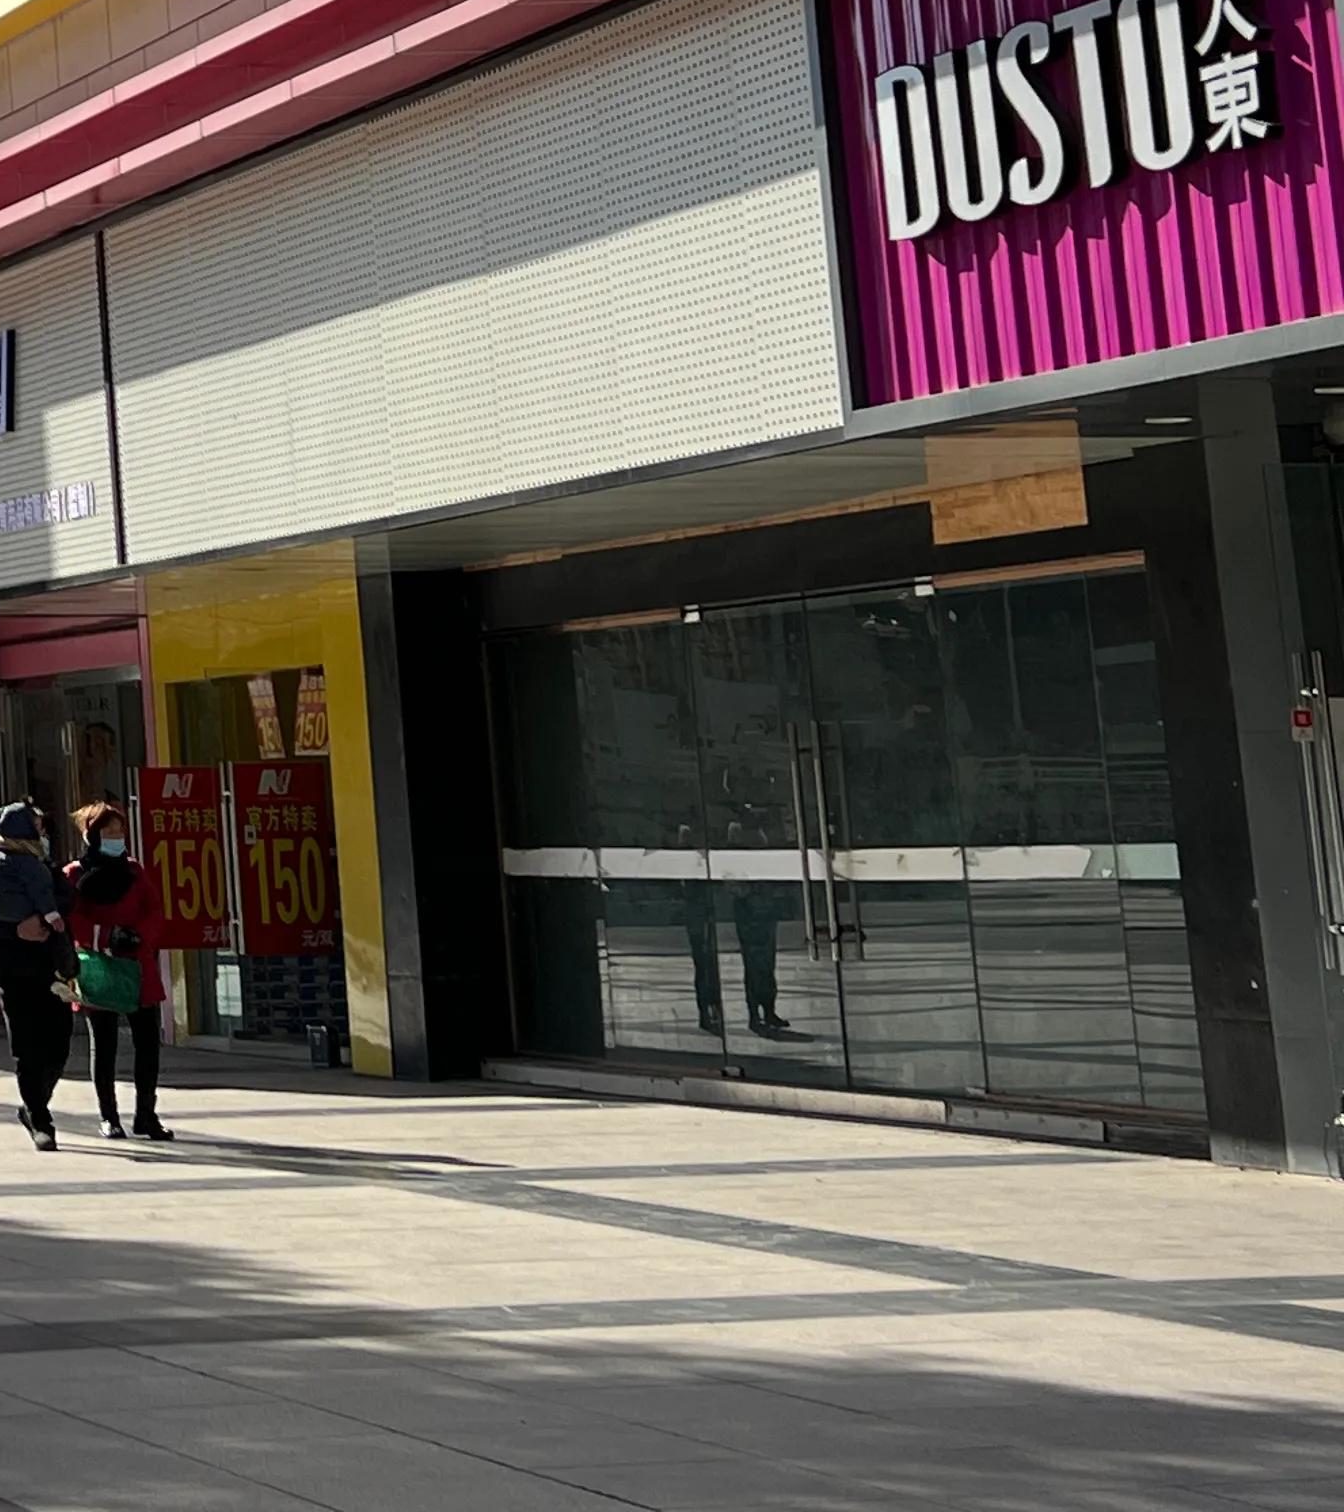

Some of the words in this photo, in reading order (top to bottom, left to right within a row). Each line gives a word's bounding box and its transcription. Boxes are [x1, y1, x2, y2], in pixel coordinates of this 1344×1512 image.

[295, 711, 326, 748] 150
[150, 808, 218, 833] 官方特卖
[246, 805, 318, 832] 官方特卖
[153, 838, 226, 921] 150
[249, 836, 326, 925] 150
